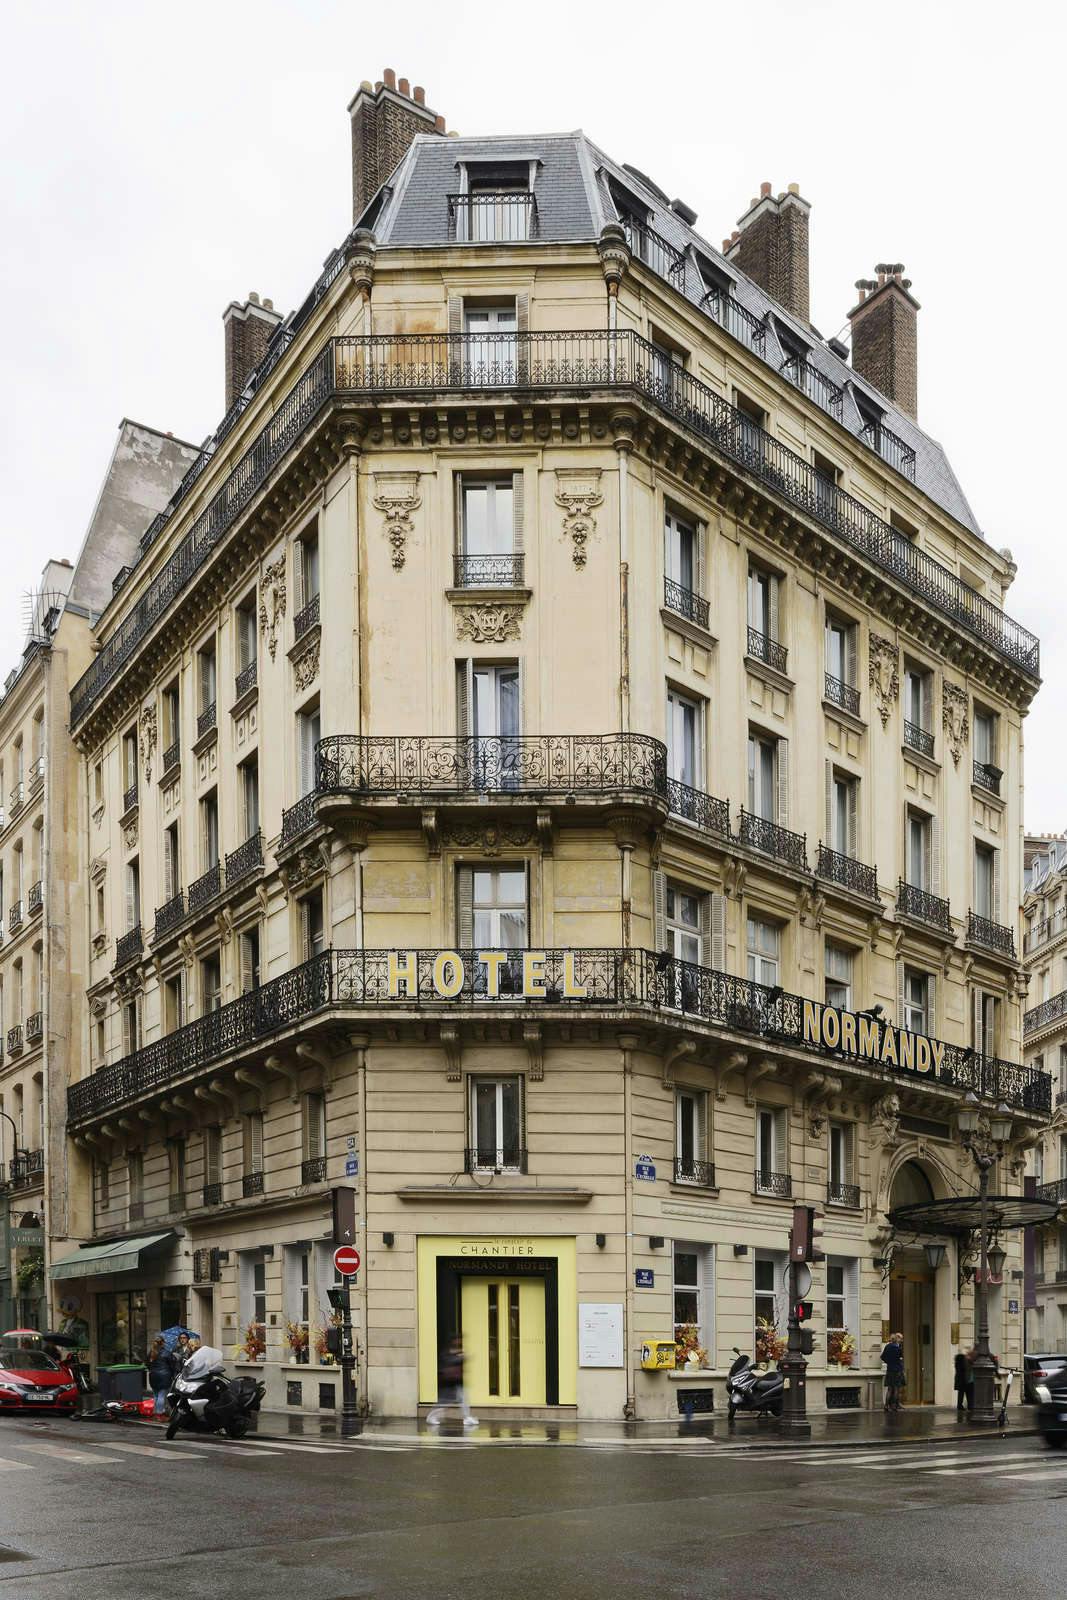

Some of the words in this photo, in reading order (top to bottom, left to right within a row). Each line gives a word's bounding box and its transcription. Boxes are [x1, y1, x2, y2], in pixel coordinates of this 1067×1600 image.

[387, 951, 588, 998] HOTEL
[803, 1000, 946, 1077] NORMANDY
[460, 1246, 534, 1255] CHANTIER
